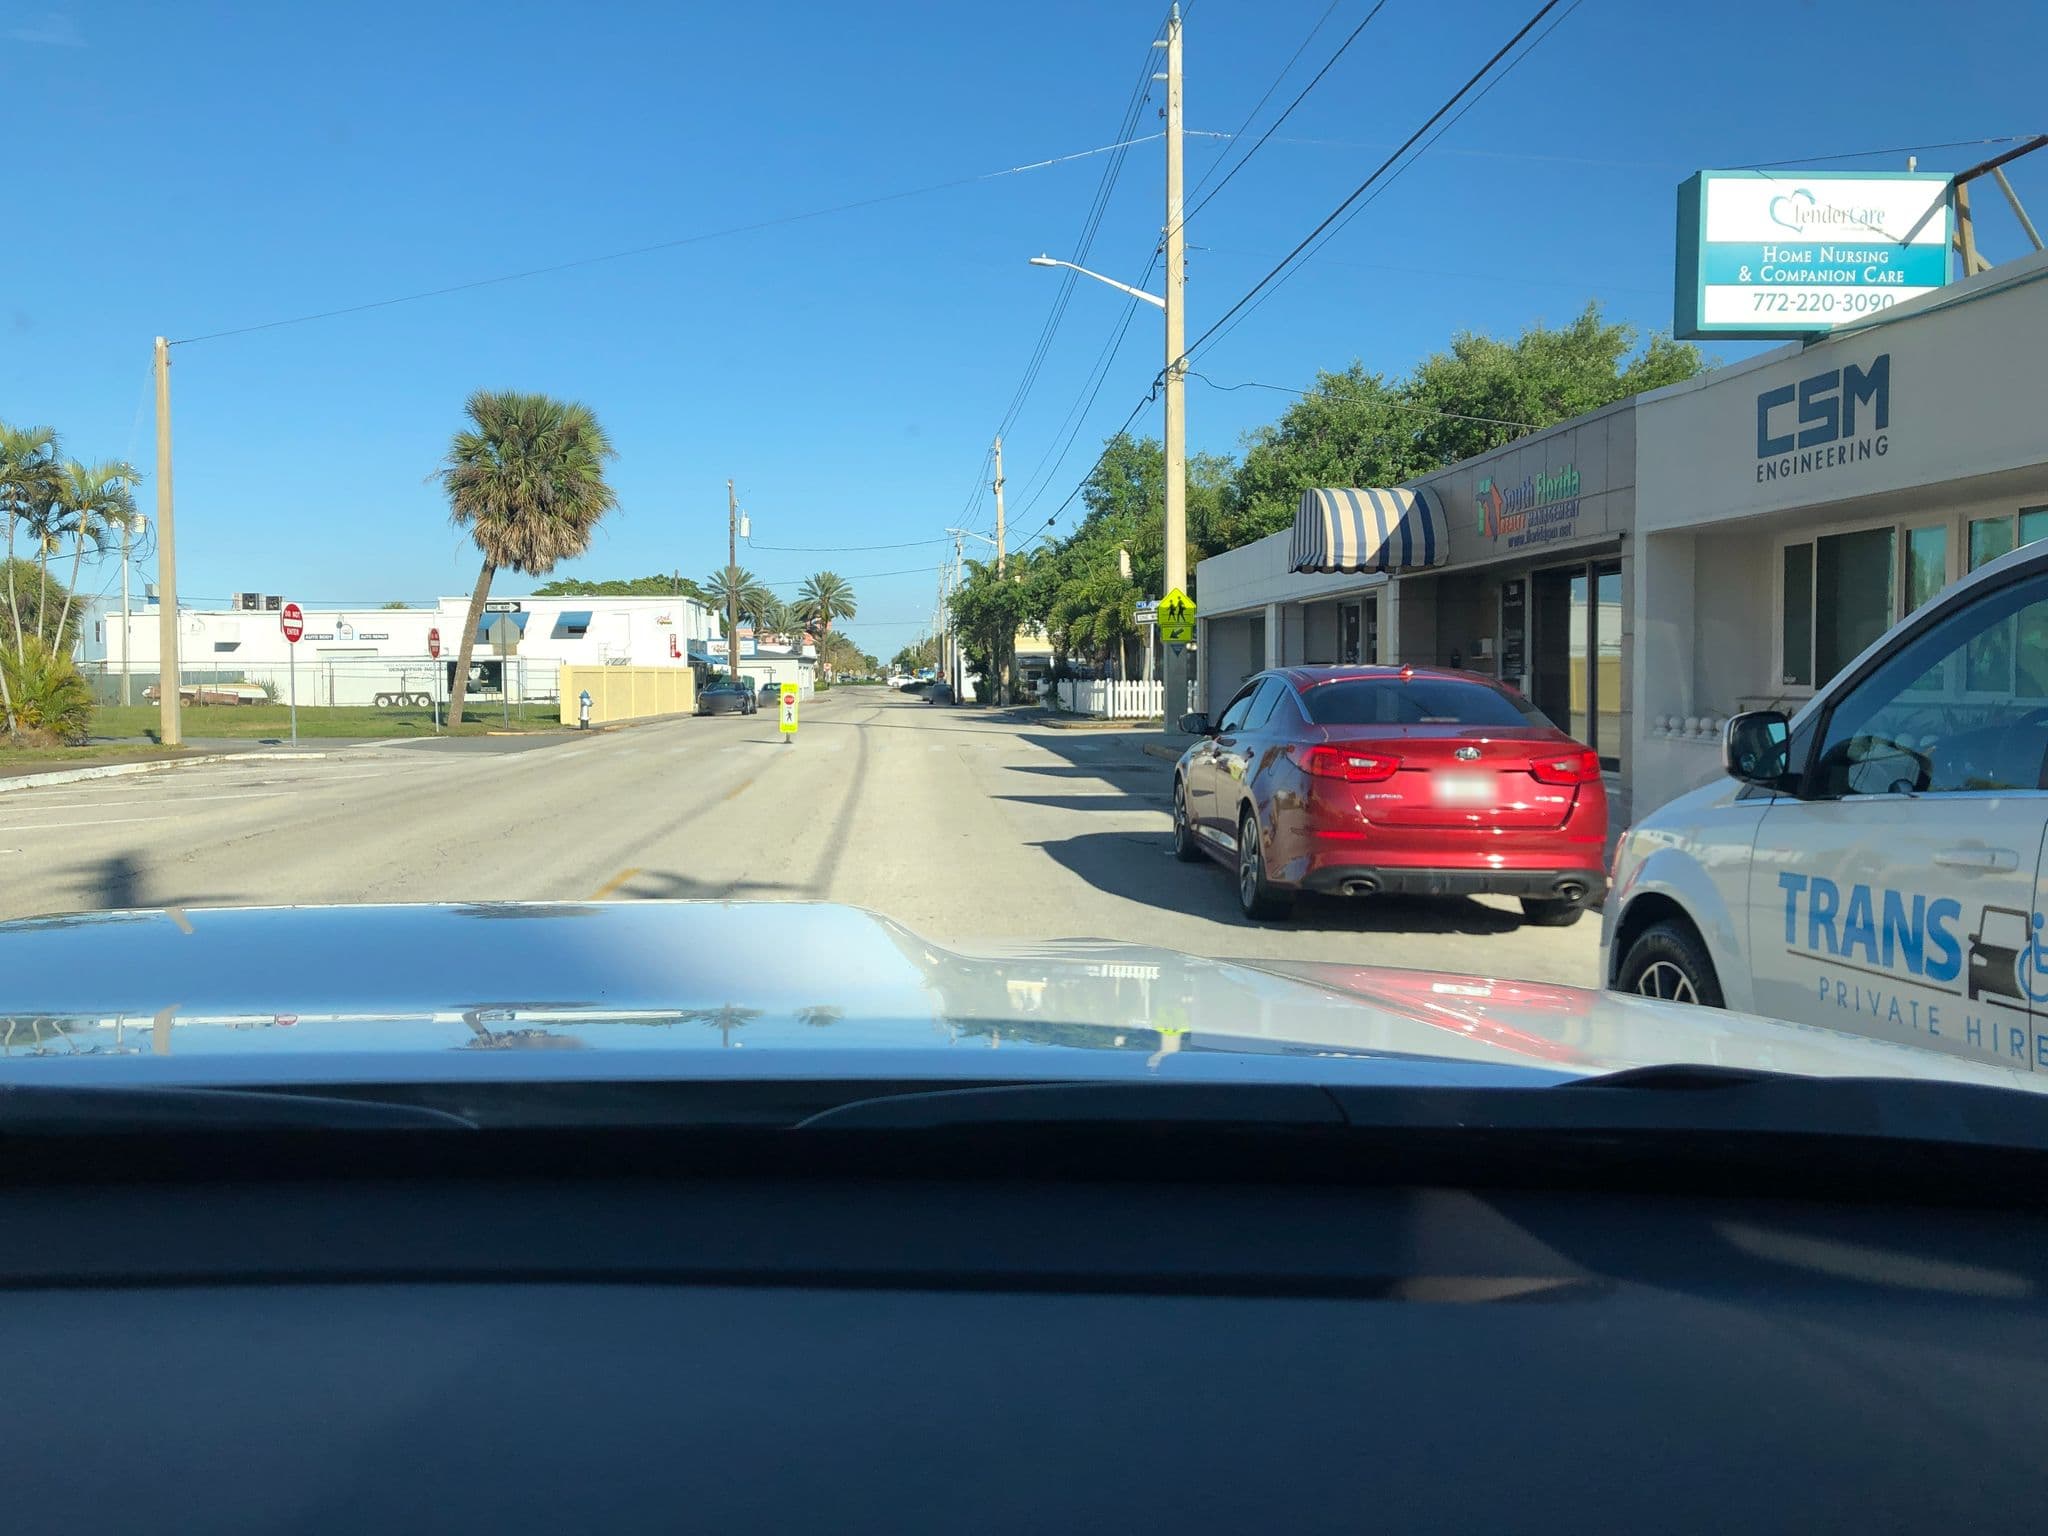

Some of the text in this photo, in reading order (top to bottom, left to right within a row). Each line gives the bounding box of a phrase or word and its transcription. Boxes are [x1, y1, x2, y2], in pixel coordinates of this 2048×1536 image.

[1763, 246, 1889, 264] HOME NURSING
[1738, 265, 1905, 283] & COMPANION CARE
[1753, 293, 1895, 312] 772-220-3090
[1757, 353, 1890, 459] CSM
[1757, 435, 1889, 483] ENGINEERING
[1503, 463, 1581, 515] South Florida
[292, 610, 301, 618] NOT
[286, 627, 300, 636] ENTER
[1778, 872, 1962, 982] TRANS
[1819, 976, 2048, 1067] PRIVATE HIRE
